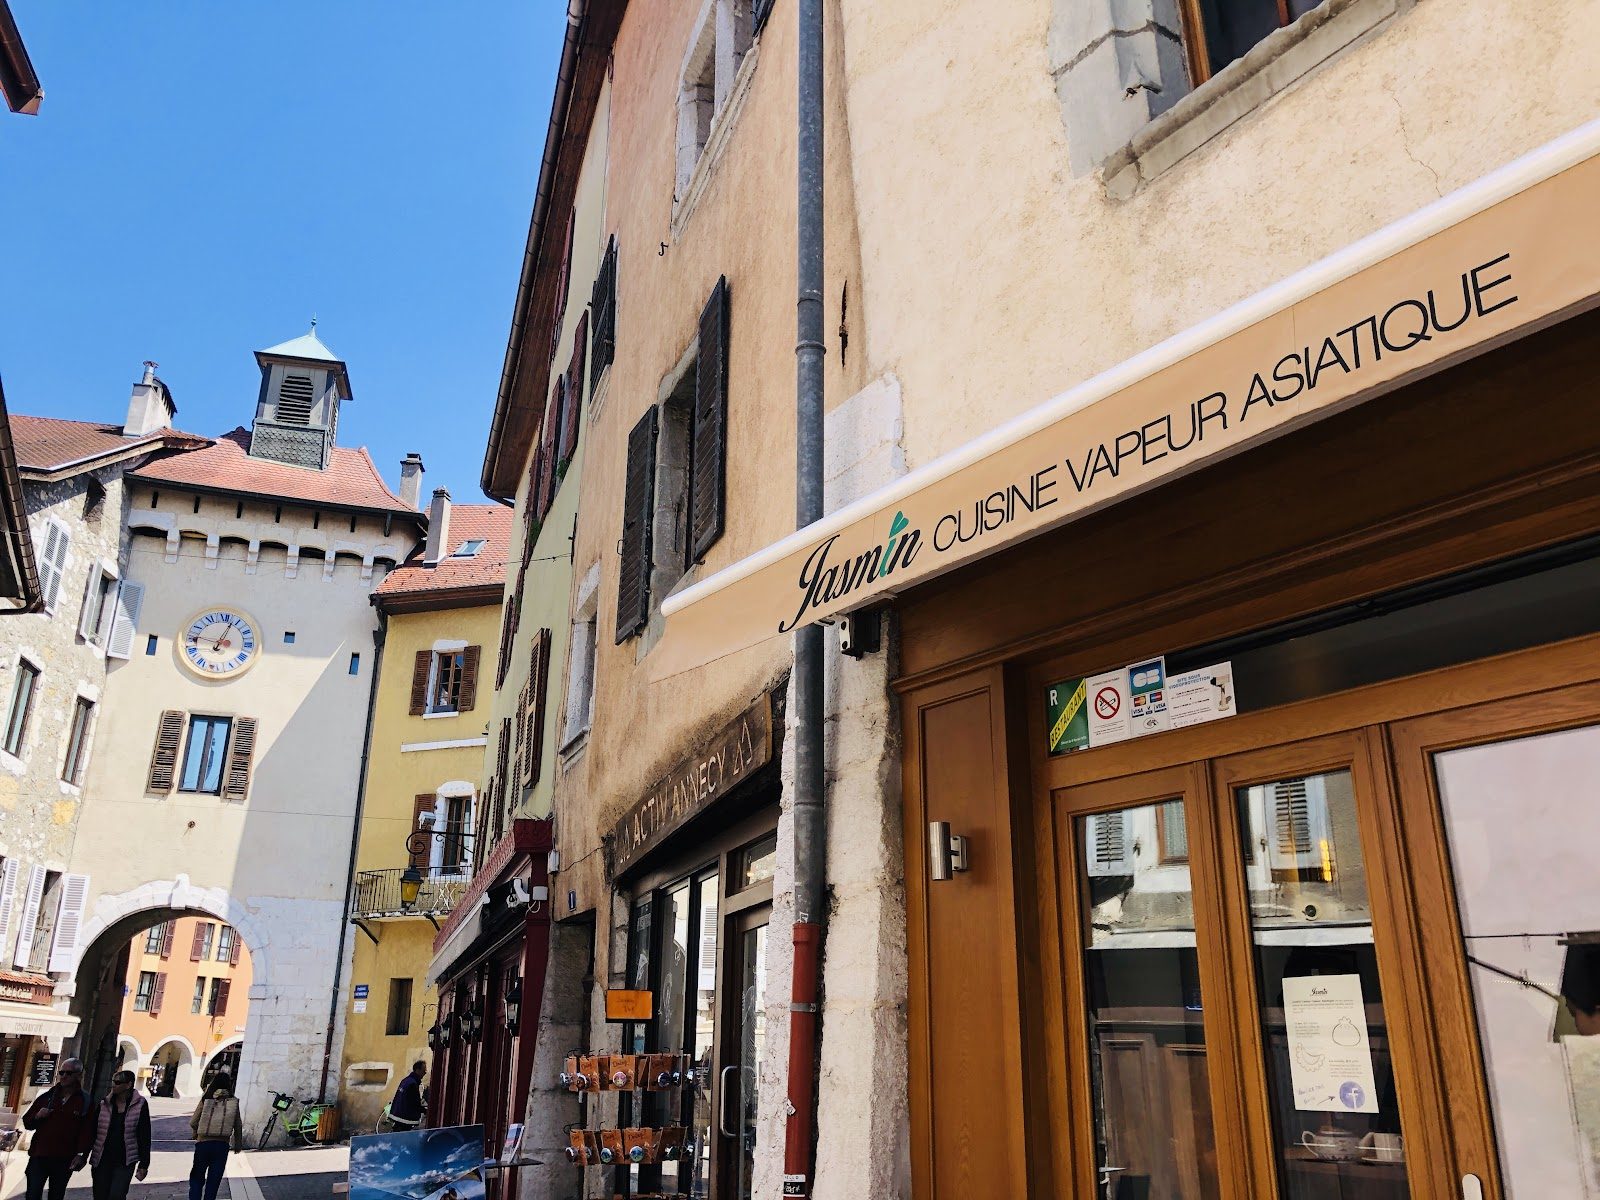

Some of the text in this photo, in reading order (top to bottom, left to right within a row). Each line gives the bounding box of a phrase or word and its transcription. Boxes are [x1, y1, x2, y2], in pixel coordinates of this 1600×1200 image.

[779, 253, 1519, 632] Jasmin CUISINE VAPEUR ASIATIQUE
[1049, 689, 1058, 706] R
[1050, 682, 1087, 747] RESTAURANT
[671, 746, 726, 821] ANNECY
